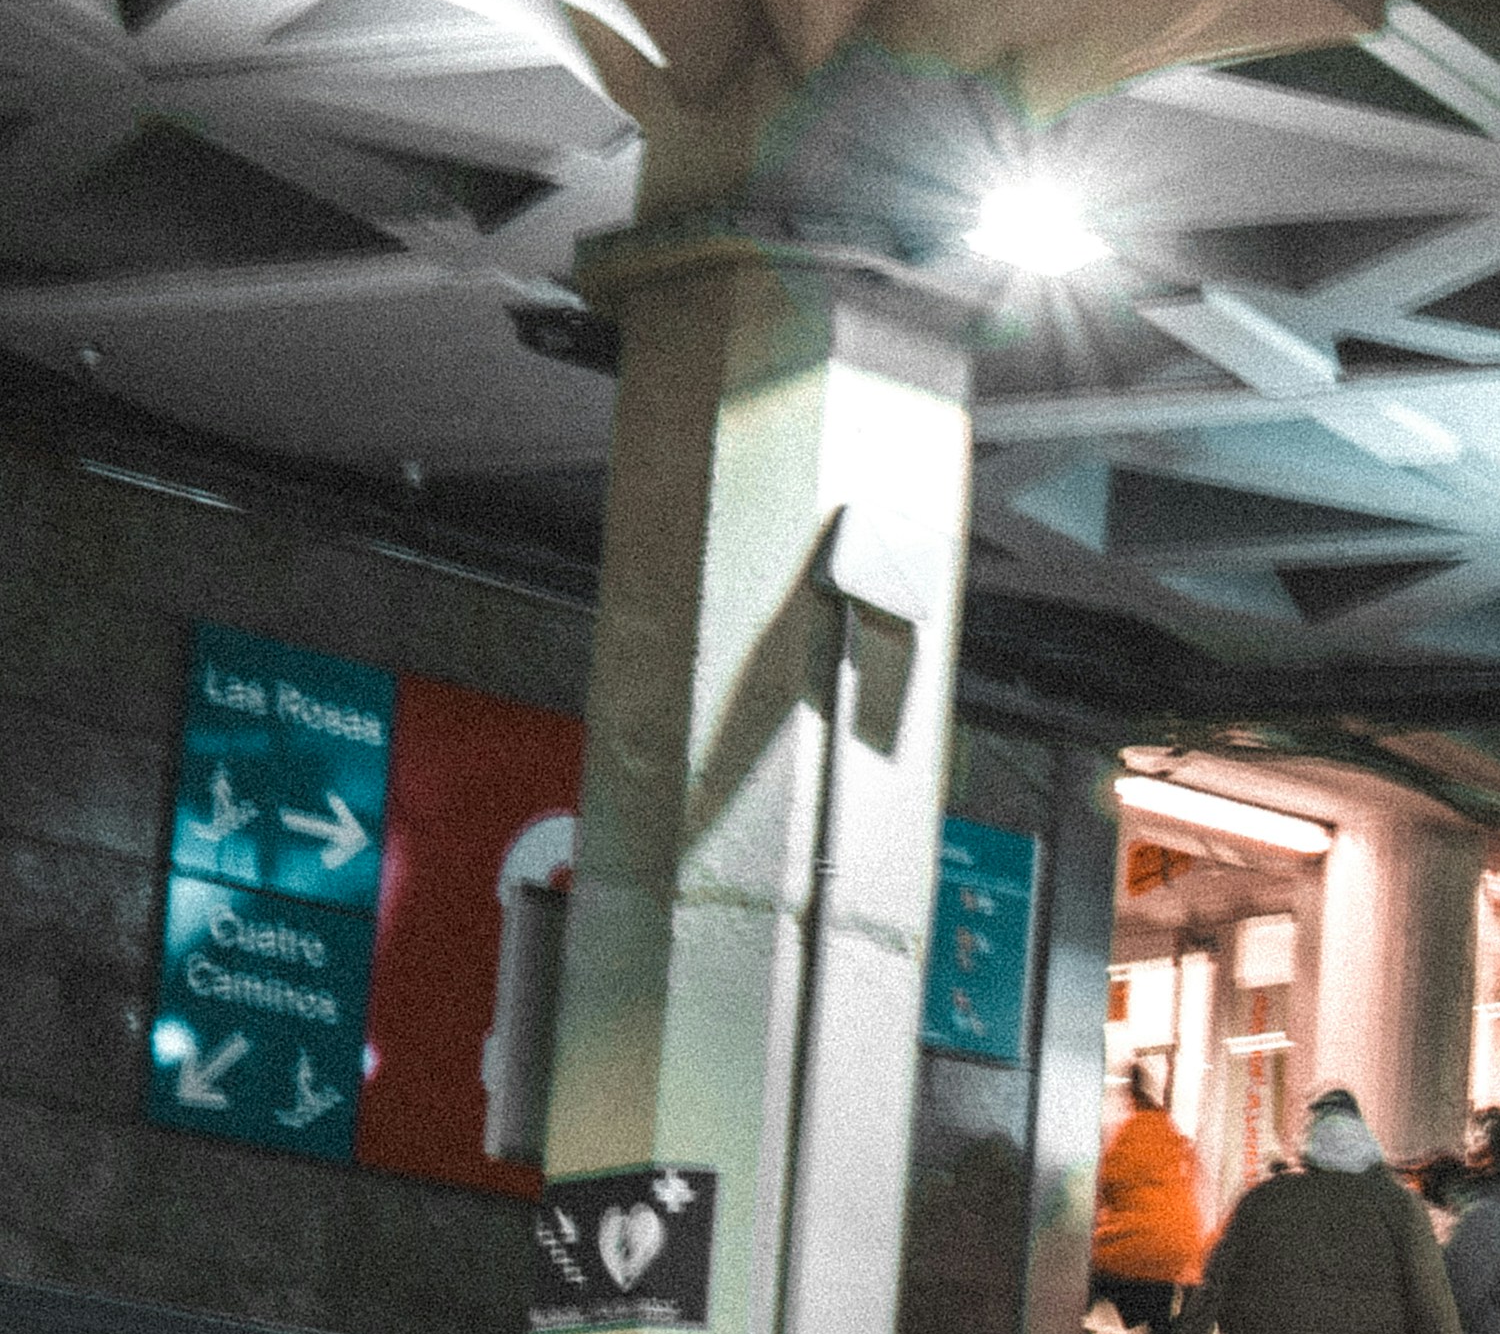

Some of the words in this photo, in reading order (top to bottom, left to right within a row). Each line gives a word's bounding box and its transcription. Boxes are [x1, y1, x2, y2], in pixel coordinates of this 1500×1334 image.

[205, 663, 267, 716] Las
[275, 679, 383, 746] Rosas
[210, 904, 326, 968] Cuatro
[187, 952, 338, 1025] Caminos
